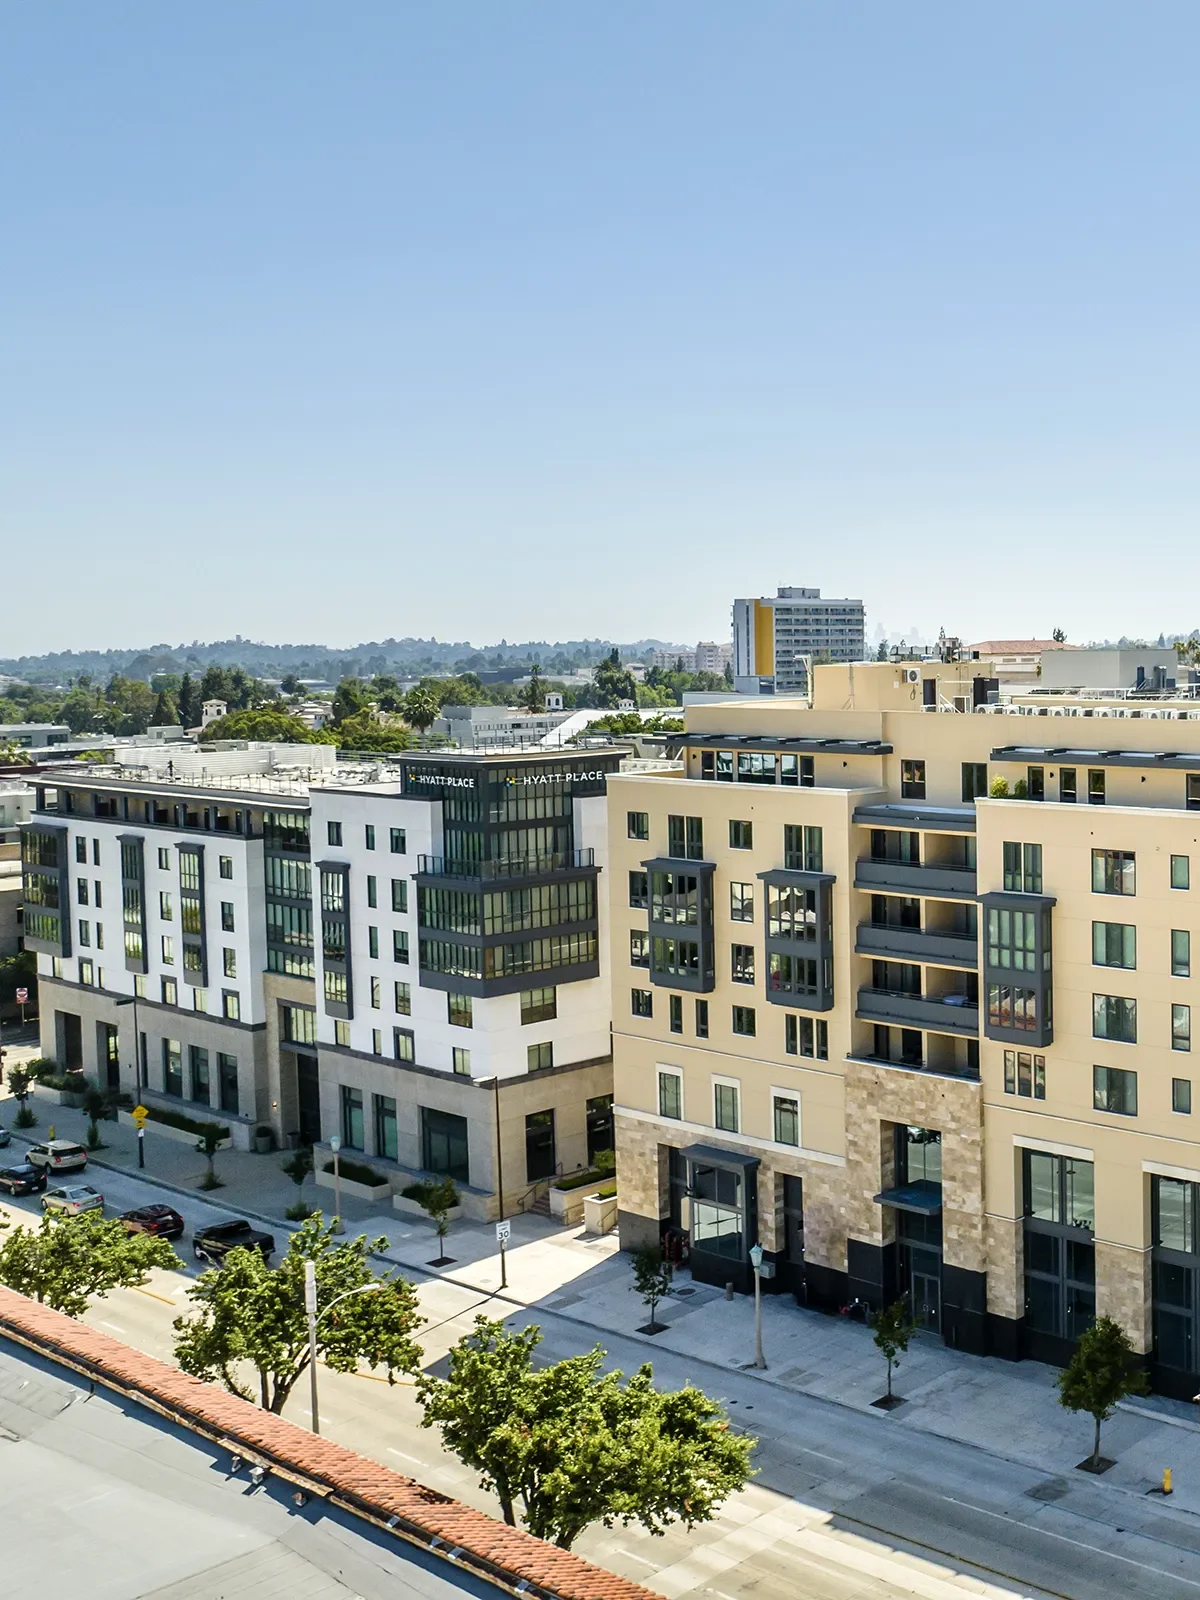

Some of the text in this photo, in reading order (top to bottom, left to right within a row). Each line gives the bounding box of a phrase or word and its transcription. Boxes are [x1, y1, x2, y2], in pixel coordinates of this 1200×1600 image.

[420, 775, 475, 788] HYATT PLACE
[523, 770, 603, 786] HYATT PLACE
[498, 1230, 510, 1240] 30
